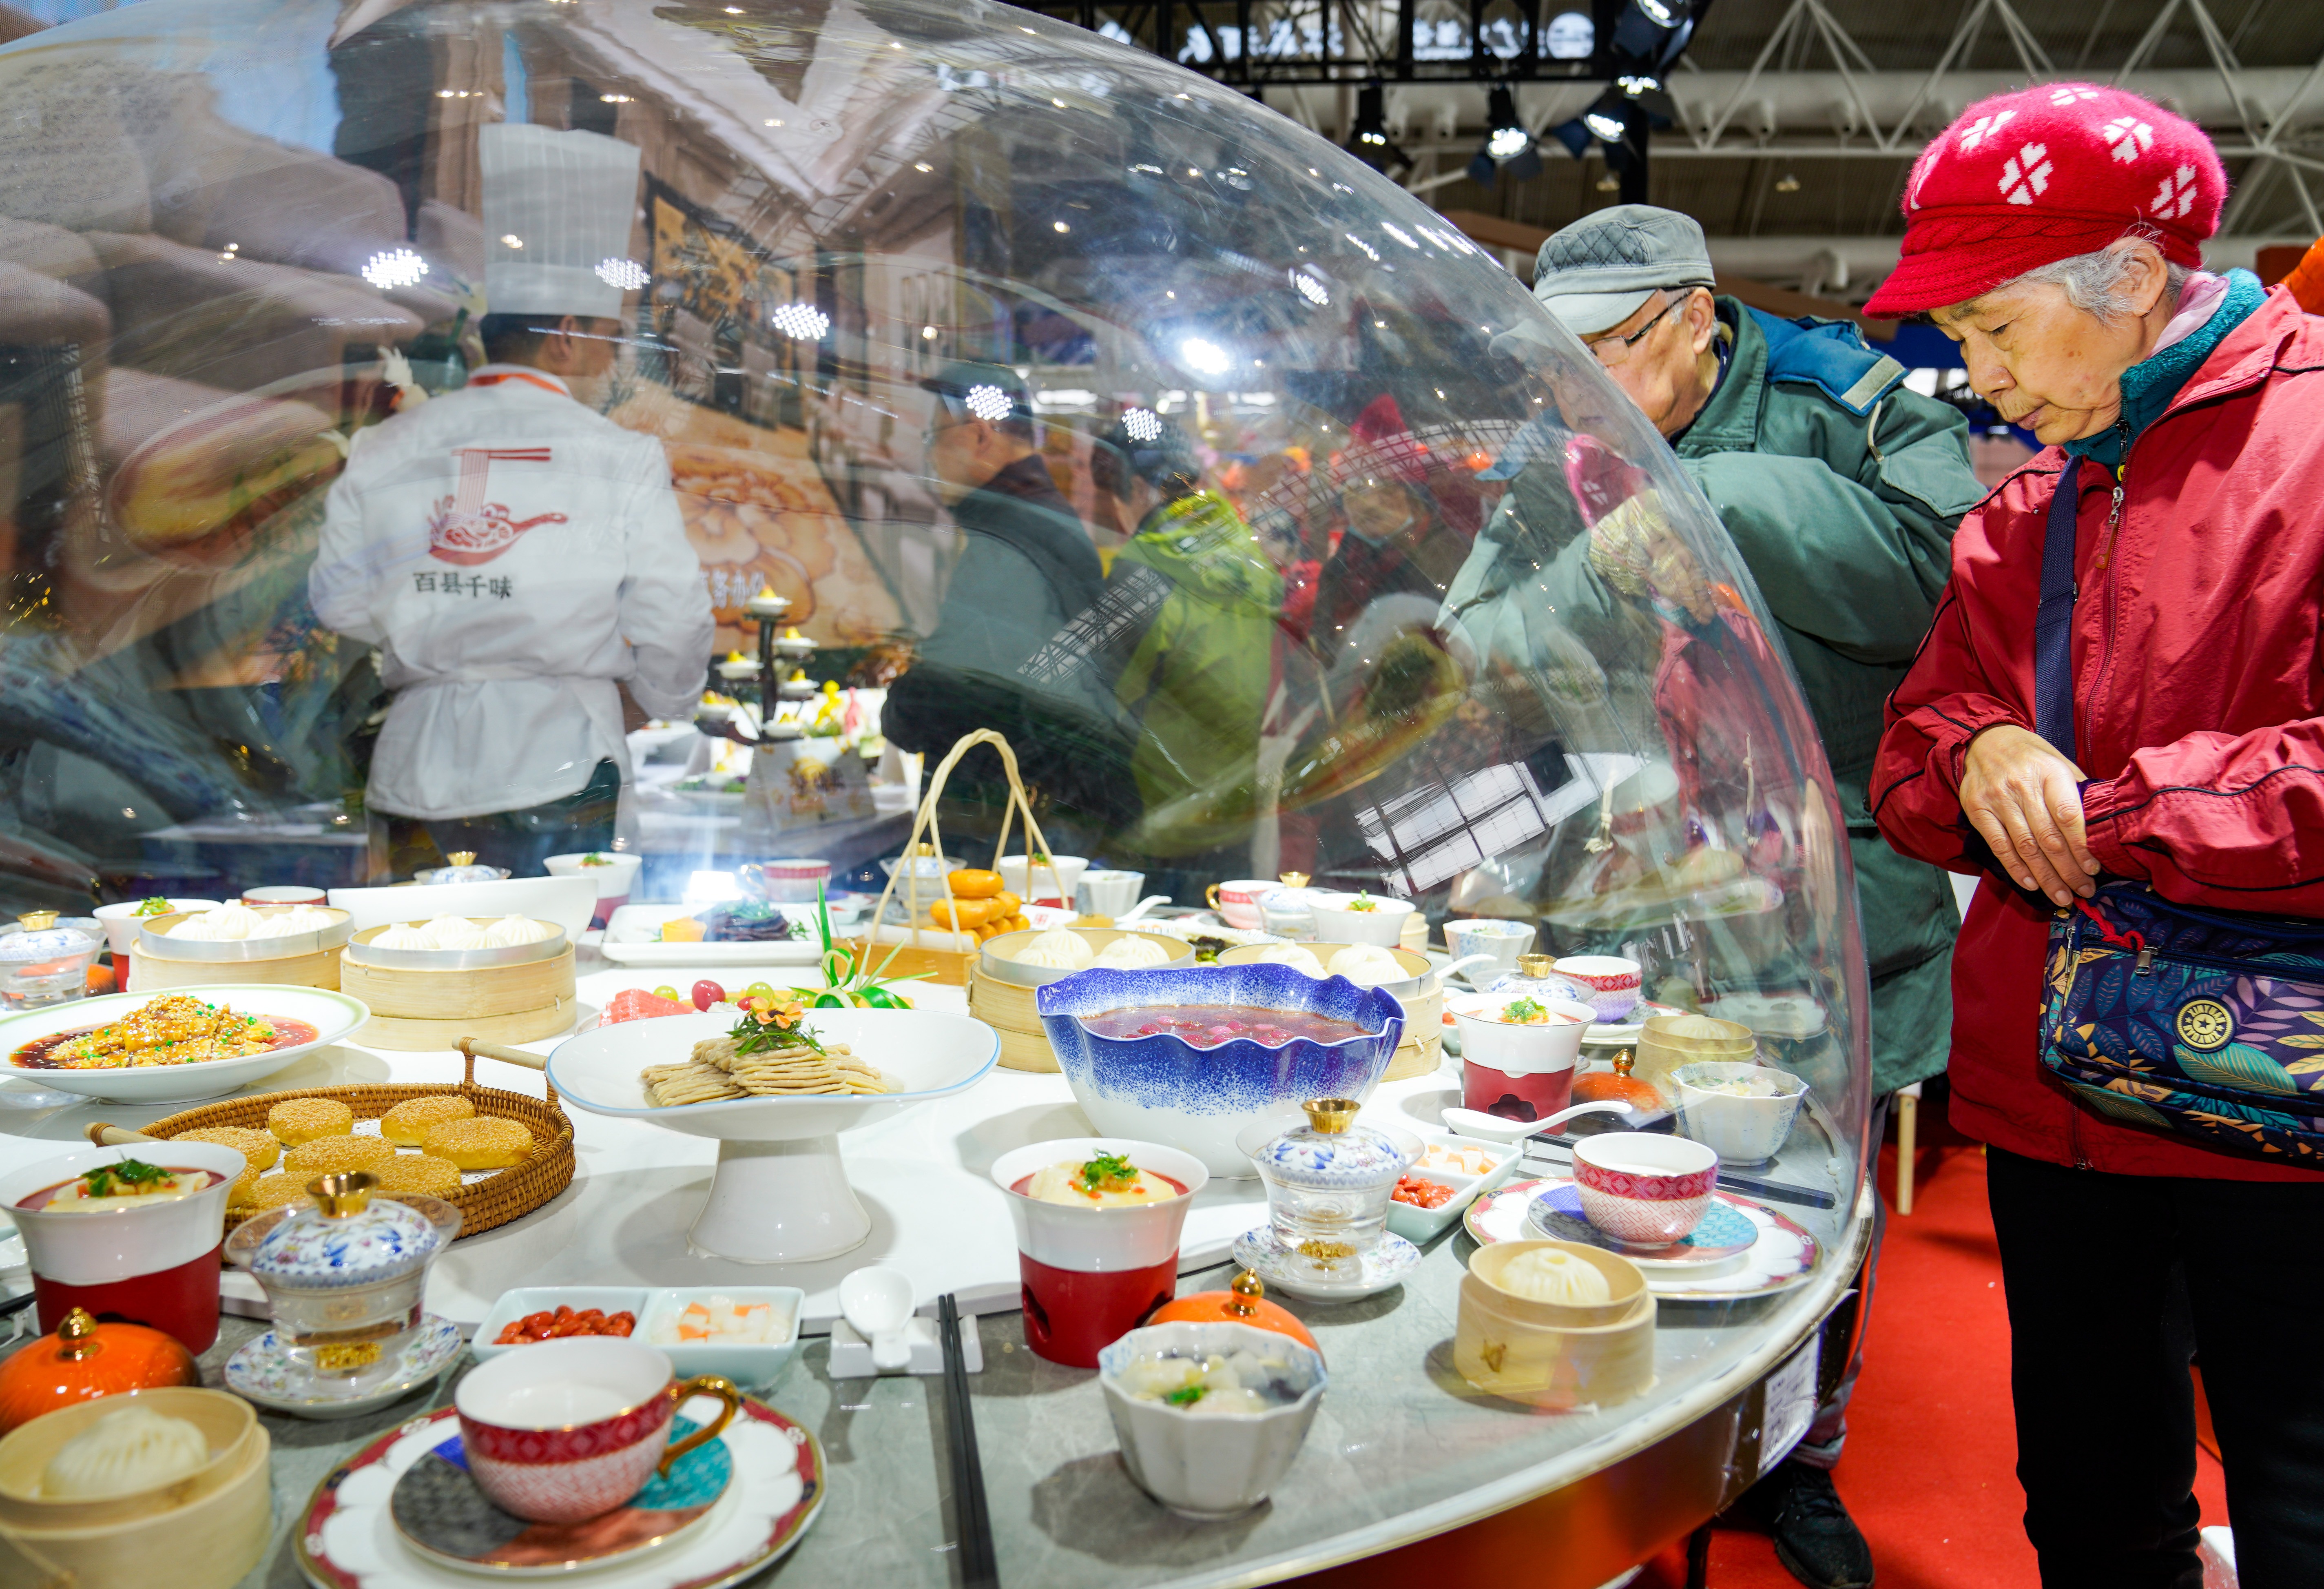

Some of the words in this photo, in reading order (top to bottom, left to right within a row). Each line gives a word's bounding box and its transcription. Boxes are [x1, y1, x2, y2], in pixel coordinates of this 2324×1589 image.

[413, 571, 512, 599] 百县千味
[2187, 1005, 2226, 1023] XINYUAN
[2183, 1025, 2222, 1044] XINYUAN
